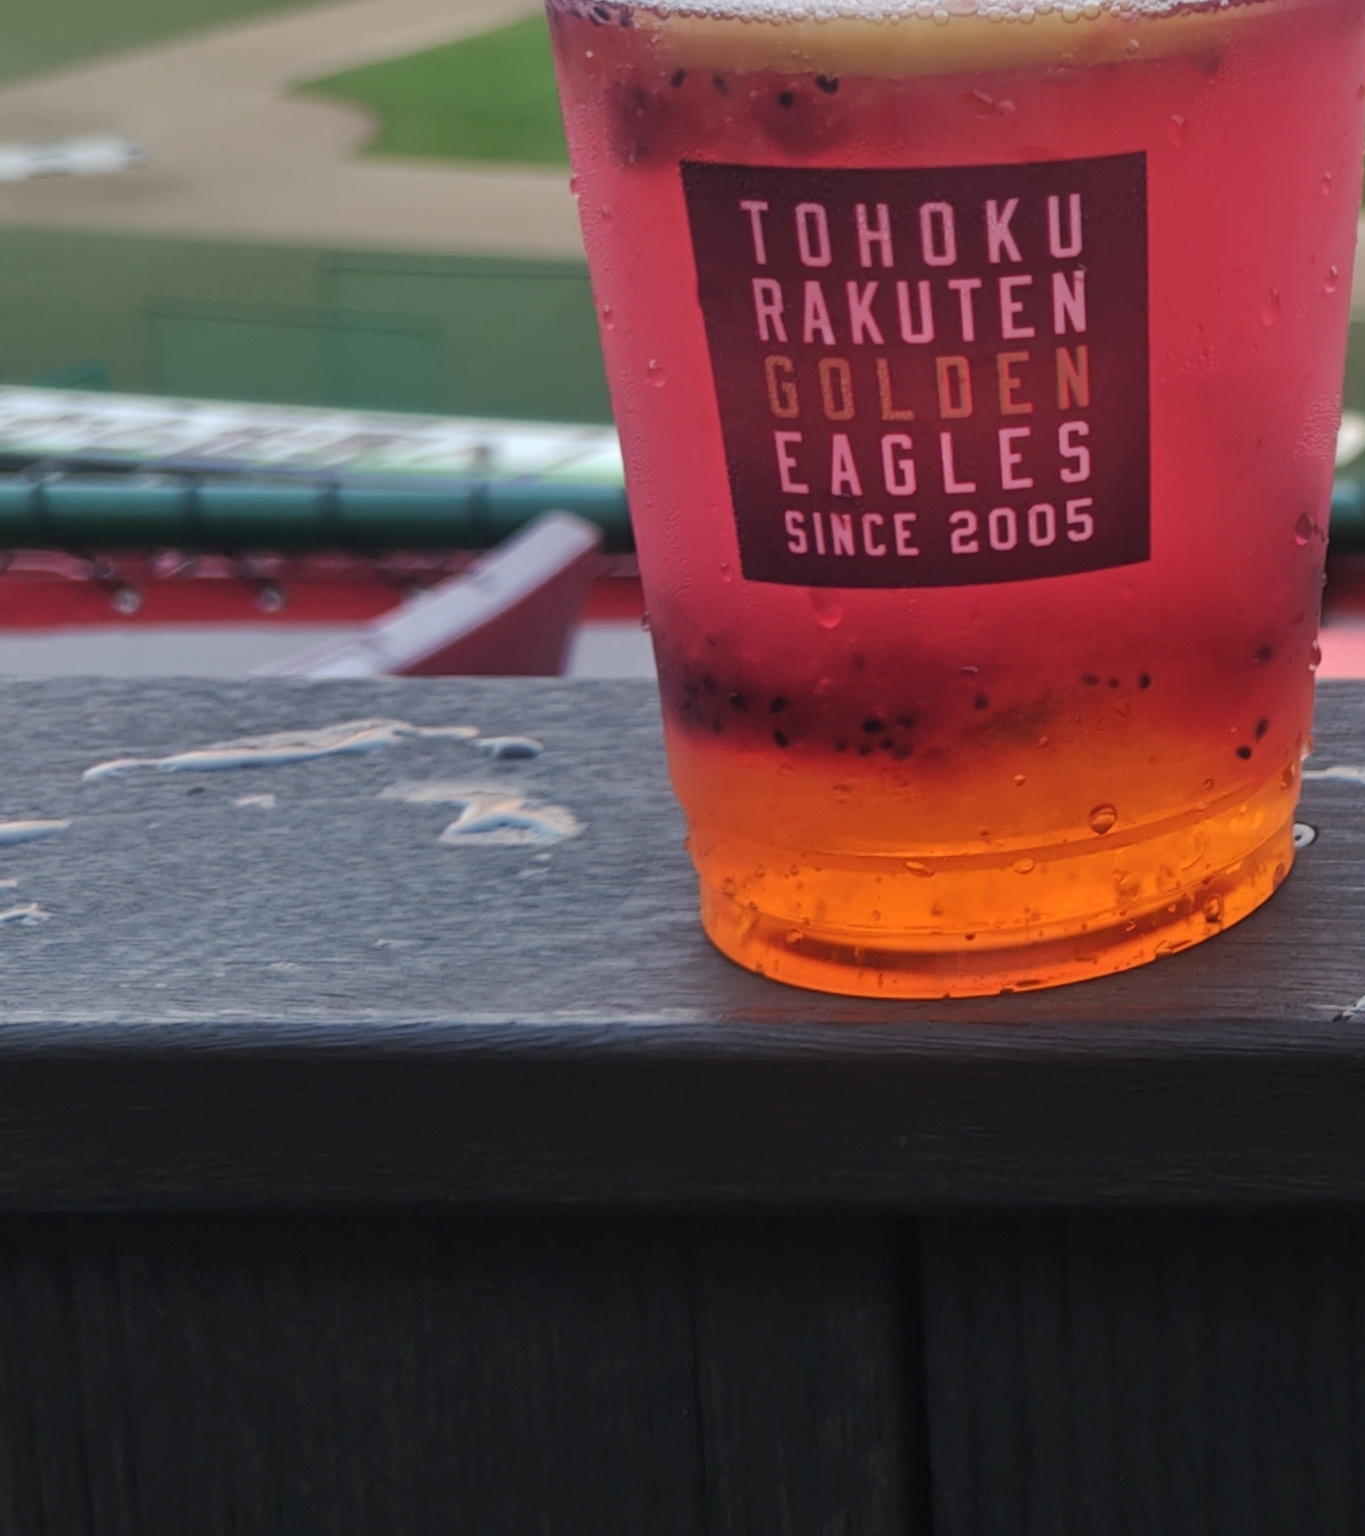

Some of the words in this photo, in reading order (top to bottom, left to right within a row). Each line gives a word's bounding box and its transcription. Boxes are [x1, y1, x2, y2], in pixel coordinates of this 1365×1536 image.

[740, 193, 1083, 268] TOHOKU
[752, 270, 1088, 346] RAKUTEN
[764, 345, 1091, 421] GOLDEN
[774, 420, 1091, 497] EAGLES
[784, 510, 919, 557] SINCE
[949, 498, 1094, 554] 2005
